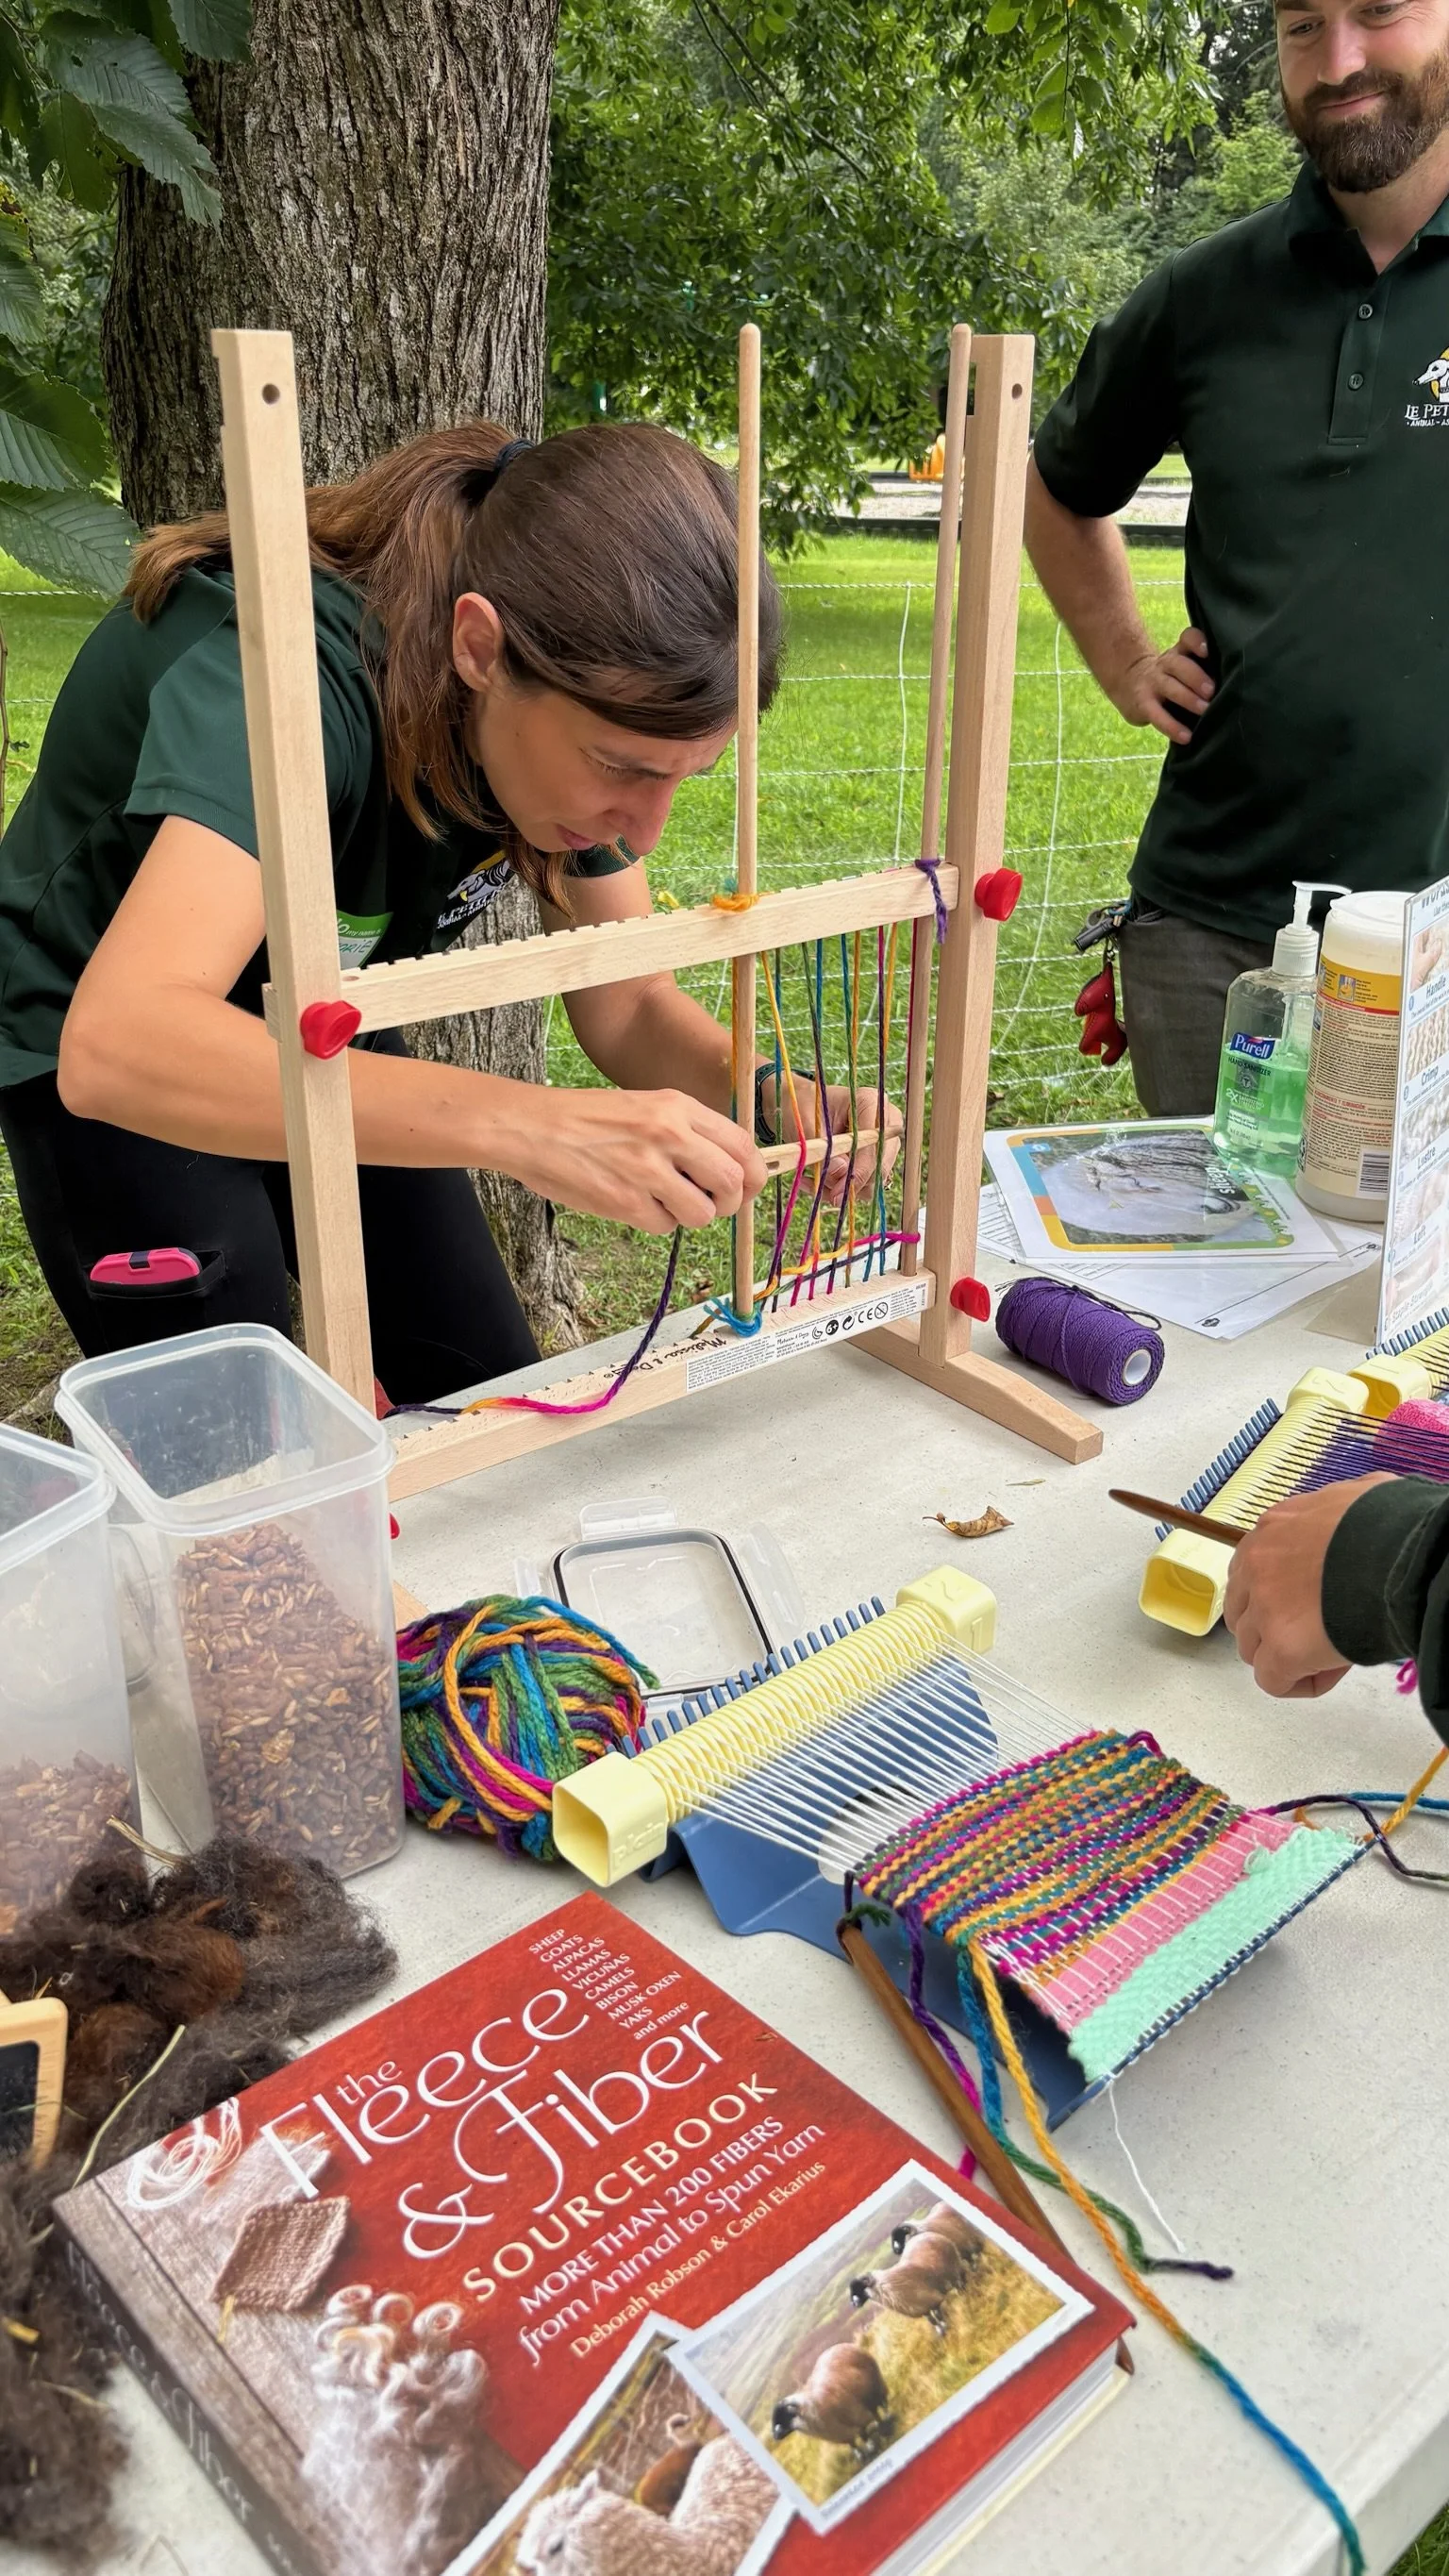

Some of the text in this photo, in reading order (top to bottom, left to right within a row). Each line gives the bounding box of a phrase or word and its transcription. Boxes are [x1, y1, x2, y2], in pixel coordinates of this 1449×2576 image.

[1405, 404, 1421, 420] LE
[1425, 975, 1447, 999] Handle
[1234, 1033, 1271, 1058] Purell
[1421, 1065, 1440, 1087] Crimp
[1225, 1088, 1239, 1103] 2X
[1417, 1146, 1436, 1170] Lustre
[1206, 1165, 1237, 1196] sheep
[1413, 1225, 1426, 1245] Loft
[528, 1929, 565, 1954] SHEEP
[540, 1934, 584, 1963] GOATS
[552, 1936, 605, 1973] ALPACAS
[561, 1949, 611, 1982] LLAMAS
[572, 1953, 630, 1991] VICUÑAS
[585, 1966, 635, 2000] CAMELS
[595, 1981, 639, 2011] BISON
[608, 1970, 682, 2020] MUSK OXEN
[619, 2006, 653, 2029] YAKS
[633, 2001, 690, 2041] and more
[259, 1988, 590, 2200] Fleece
[336, 2060, 403, 2106] the
[397, 2010, 724, 2260] & Fiber
[462, 2072, 778, 2304] SOURCEBOOK
[519, 2116, 785, 2316] MORE THAN 200 FIBERS
[518, 2122, 826, 2367] from Animal to Spun Yarn
[569, 2160, 827, 2358] Deborah Robson & Carol Ekarius
